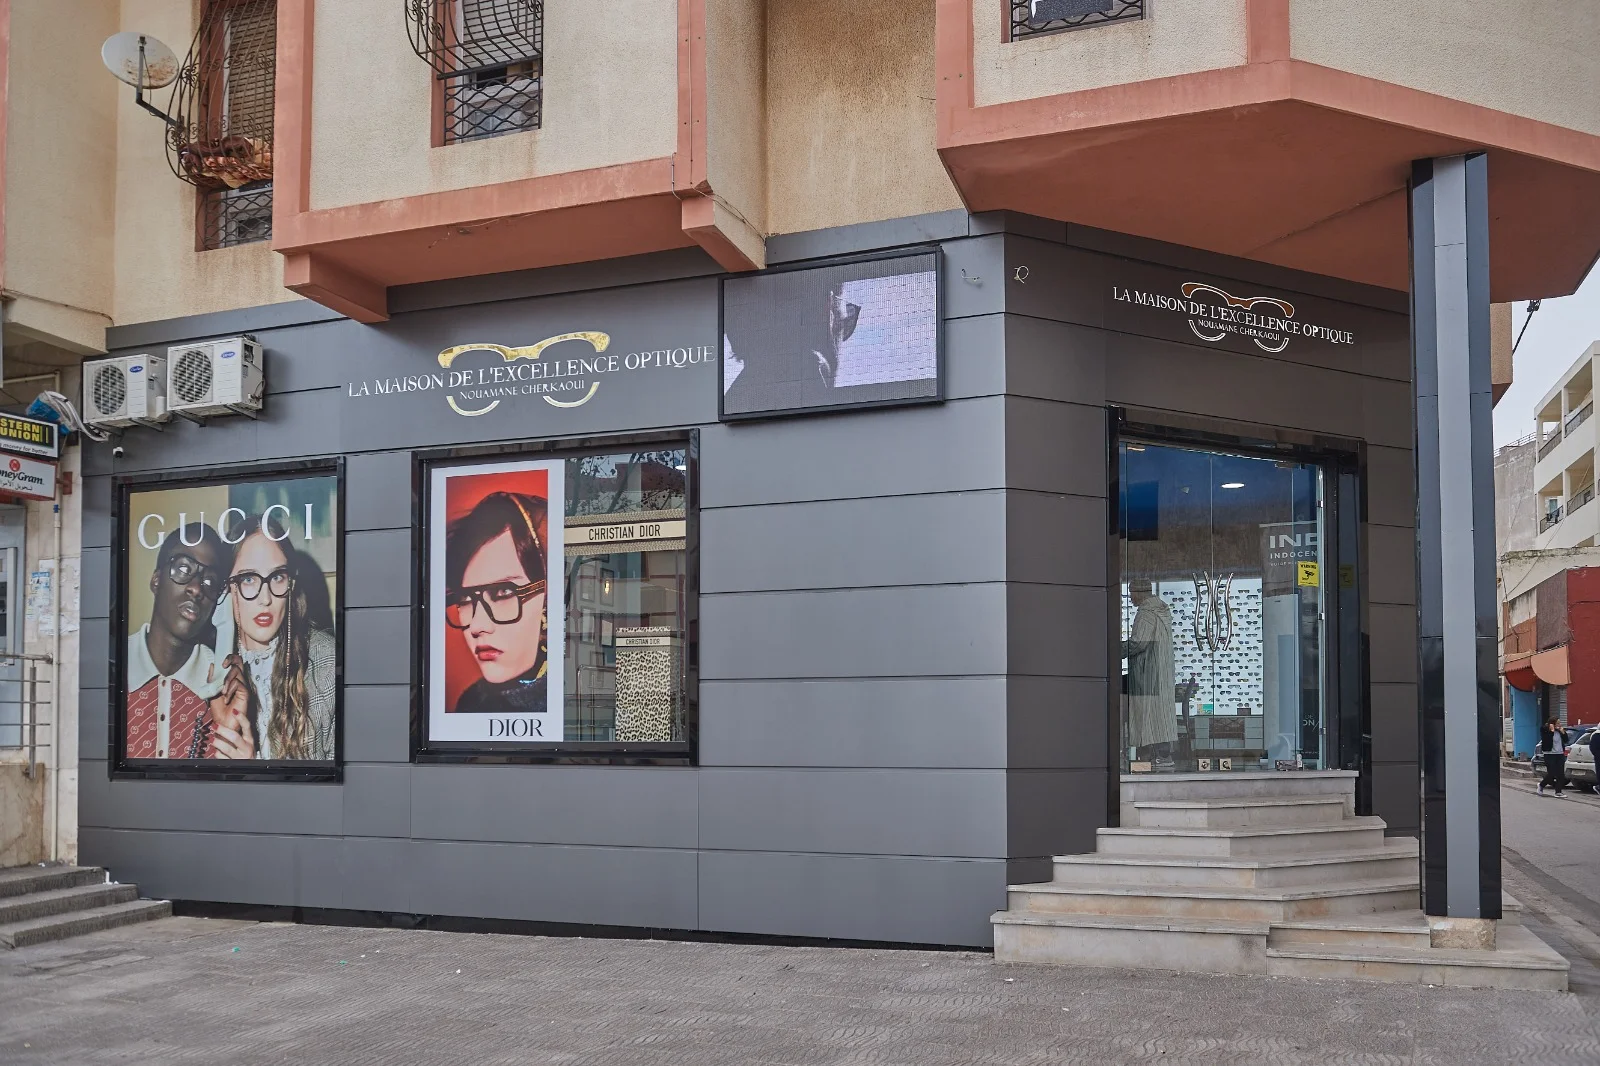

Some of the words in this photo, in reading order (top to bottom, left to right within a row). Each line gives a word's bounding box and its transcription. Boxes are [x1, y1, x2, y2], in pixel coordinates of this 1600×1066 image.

[1113, 286, 1131, 302] LA
[1134, 291, 1187, 313] MAISON
[1190, 301, 1208, 317] DE
[1210, 305, 1300, 334] L'EXCELLENCE
[1303, 323, 1354, 345] OPTIQUE
[1198, 318, 1238, 334] NOUAMANE
[1239, 326, 1280, 341] CHERKAOUI
[348, 381, 371, 398] LA
[374, 373, 444, 395] MAISON
[448, 370, 474, 388] DE
[478, 354, 620, 385] L'EXCELLENCE
[624, 345, 716, 370] OPTIQUE
[459, 387, 518, 401] NOUAMANE
[521, 379, 585, 395] CHERKAOUI
[0, 418, 40, 433] STERN
[0, 427, 40, 442] UNION
[138, 503, 313, 550] GUCCI
[588, 525, 634, 541] CHRISTIAN
[640, 524, 661, 537] DIOR
[489, 718, 544, 737] DIOR
